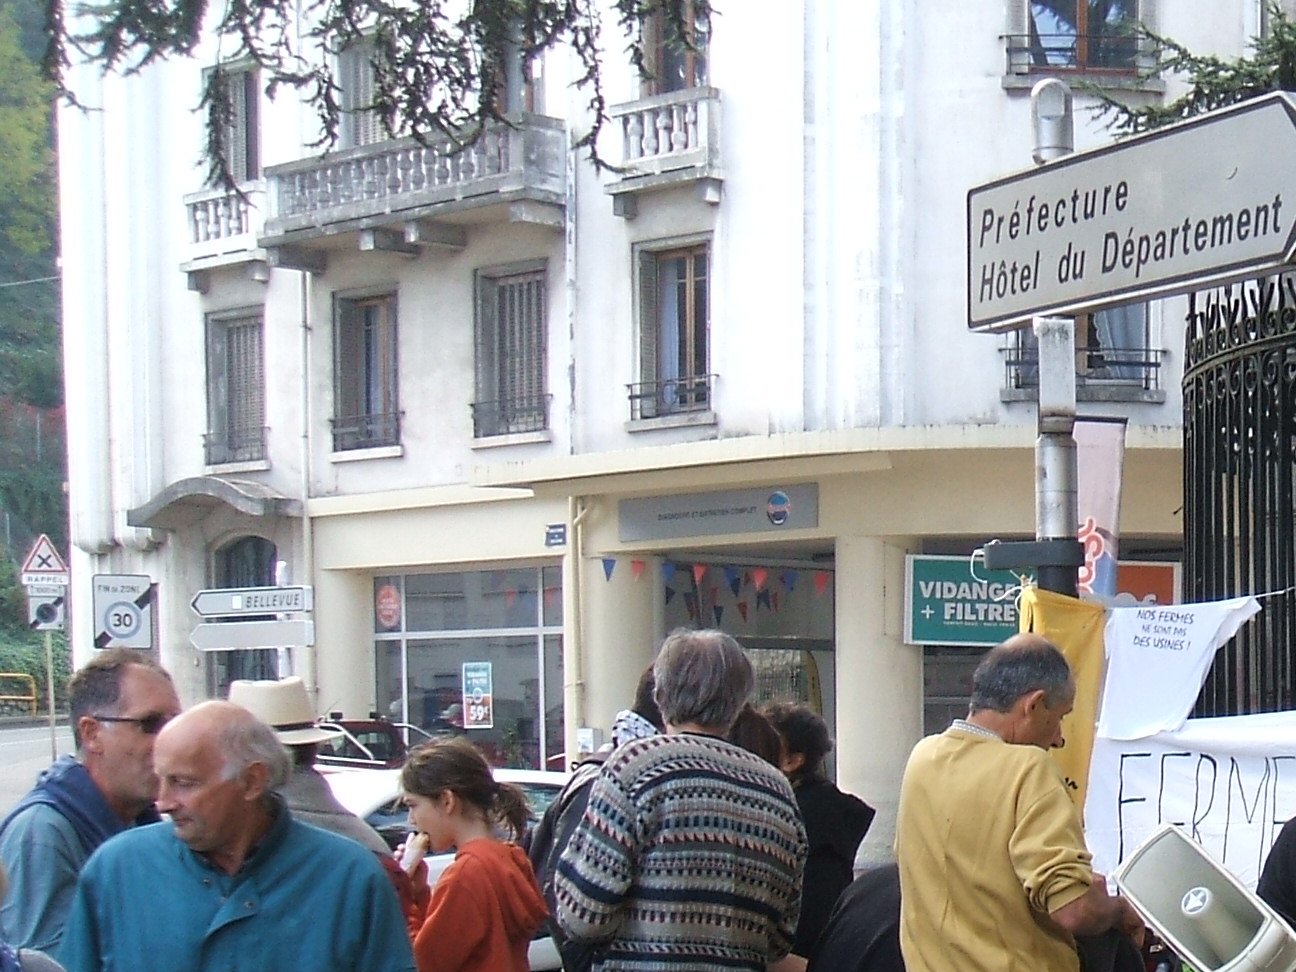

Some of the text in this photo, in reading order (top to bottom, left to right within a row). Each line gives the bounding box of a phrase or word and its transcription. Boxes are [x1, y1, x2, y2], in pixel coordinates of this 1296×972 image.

[980, 179, 1129, 248] Préfecture
[979, 193, 1283, 303] Hôtel du Département
[919, 581, 1015, 600] VIDANGE
[246, 594, 300, 608] BELLEVUE
[944, 602, 1016, 621] FILTRE
[1136, 609, 1195, 625] NOS FERMES
[112, 613, 133, 628] 30
[1153, 625, 1171, 635] SONT
[1133, 635, 1151, 647] DES
[1153, 637, 1185, 650] USINES
